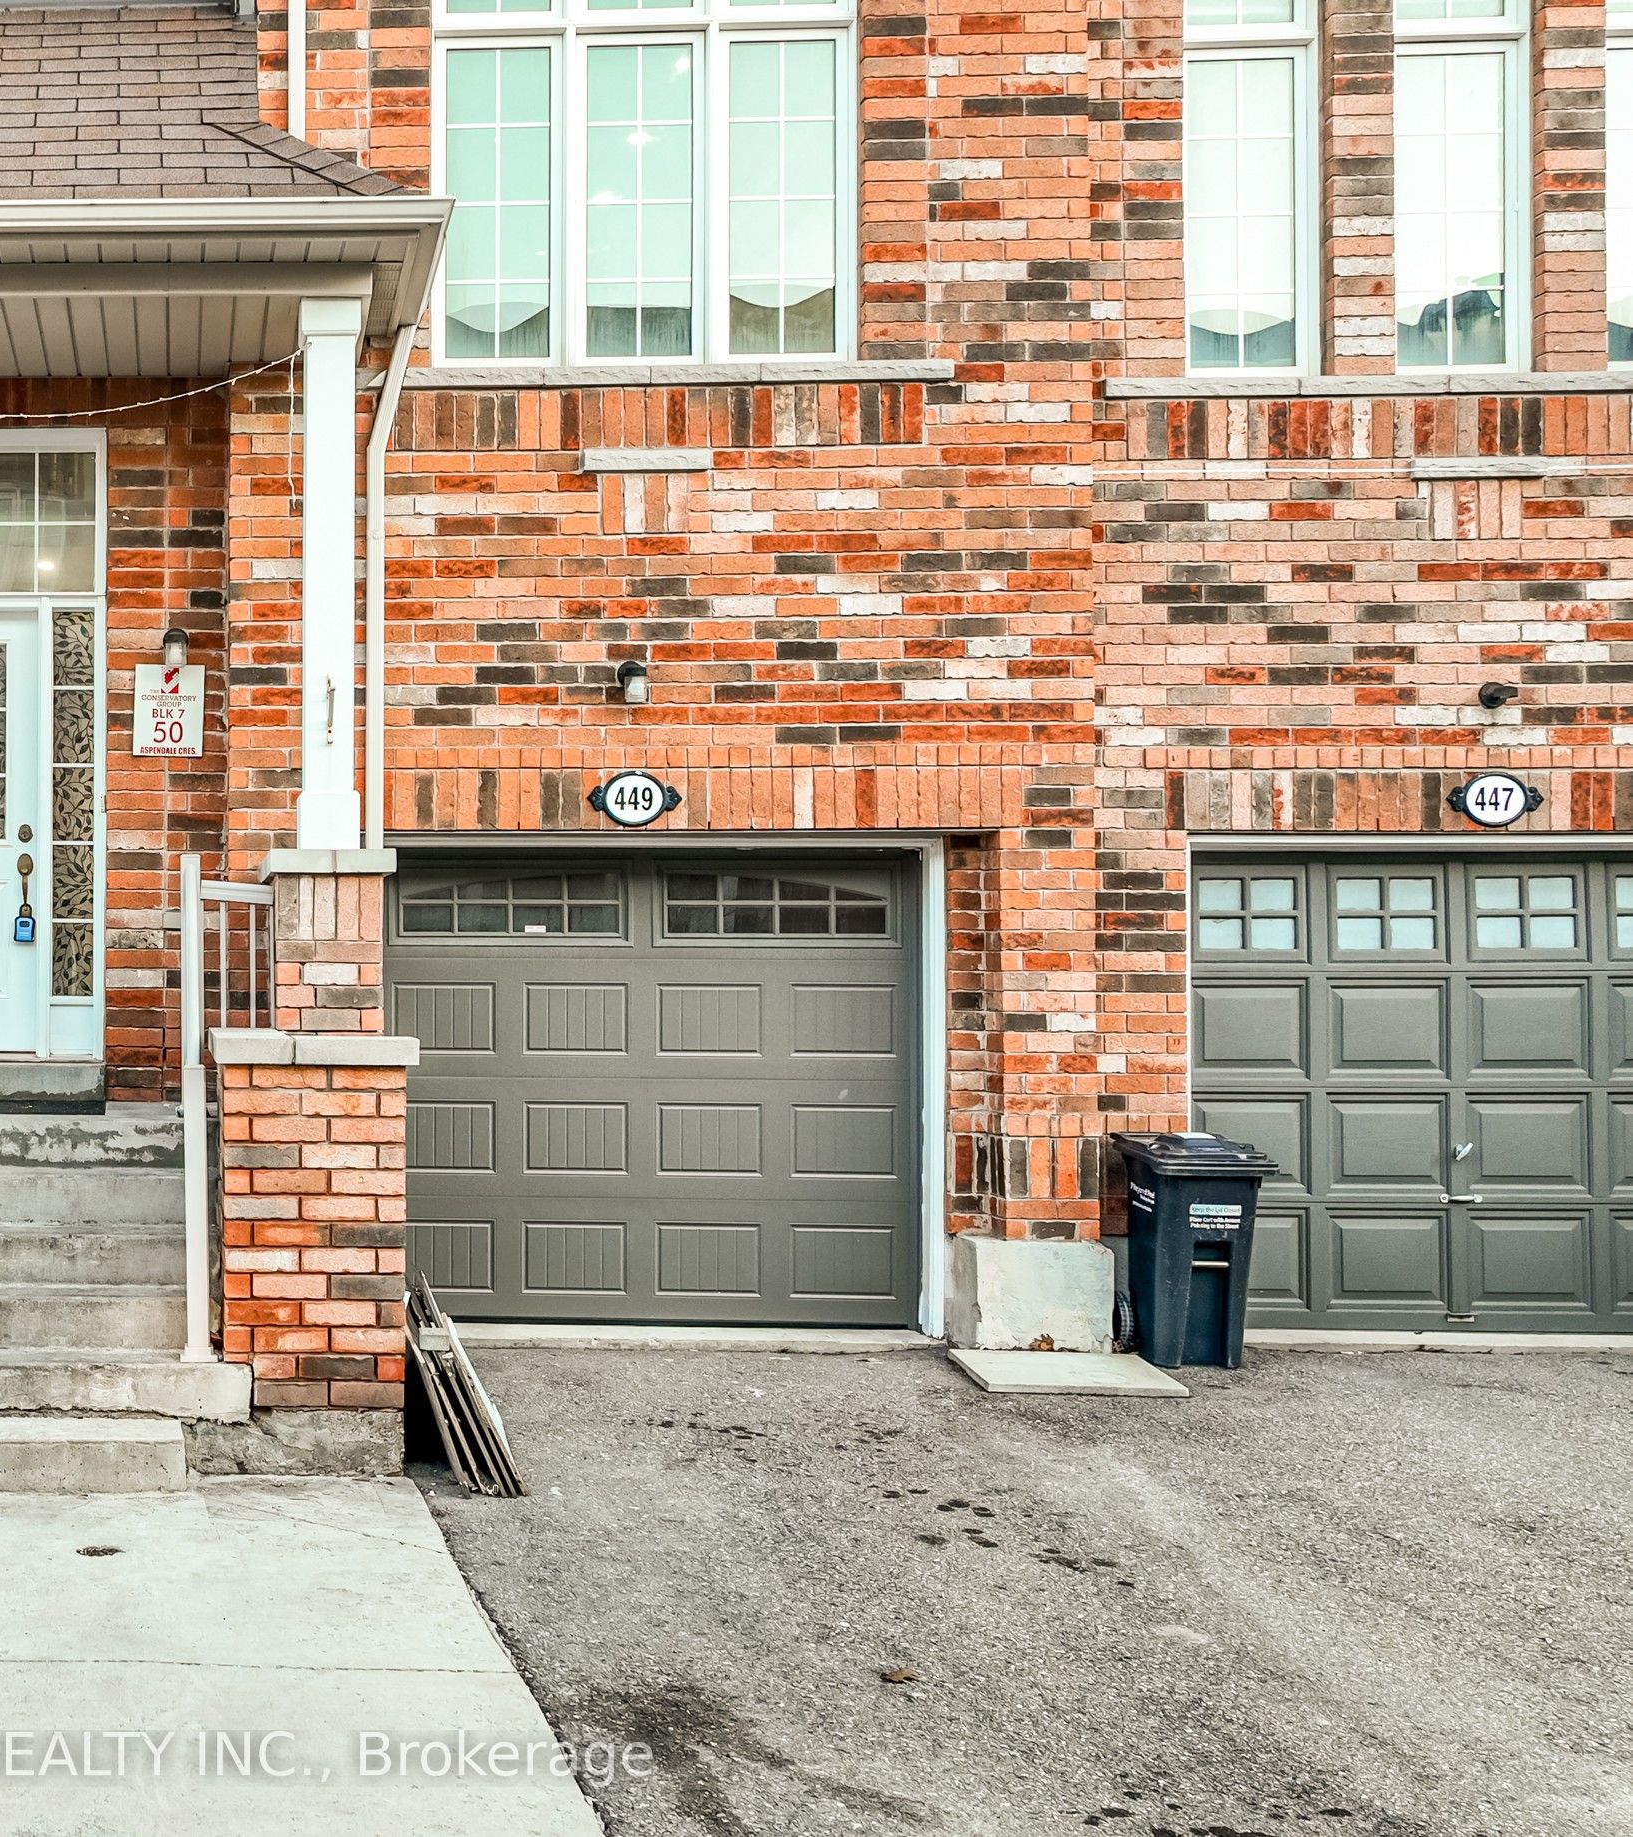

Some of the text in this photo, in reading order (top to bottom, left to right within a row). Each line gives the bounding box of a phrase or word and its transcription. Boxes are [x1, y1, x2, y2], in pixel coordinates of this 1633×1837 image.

[141, 694, 197, 702] CONSERVATORY
[152, 709, 185, 719] BLK 7
[153, 721, 183, 743] 50
[615, 787, 653, 811] 449
[1475, 787, 1514, 811] 447
